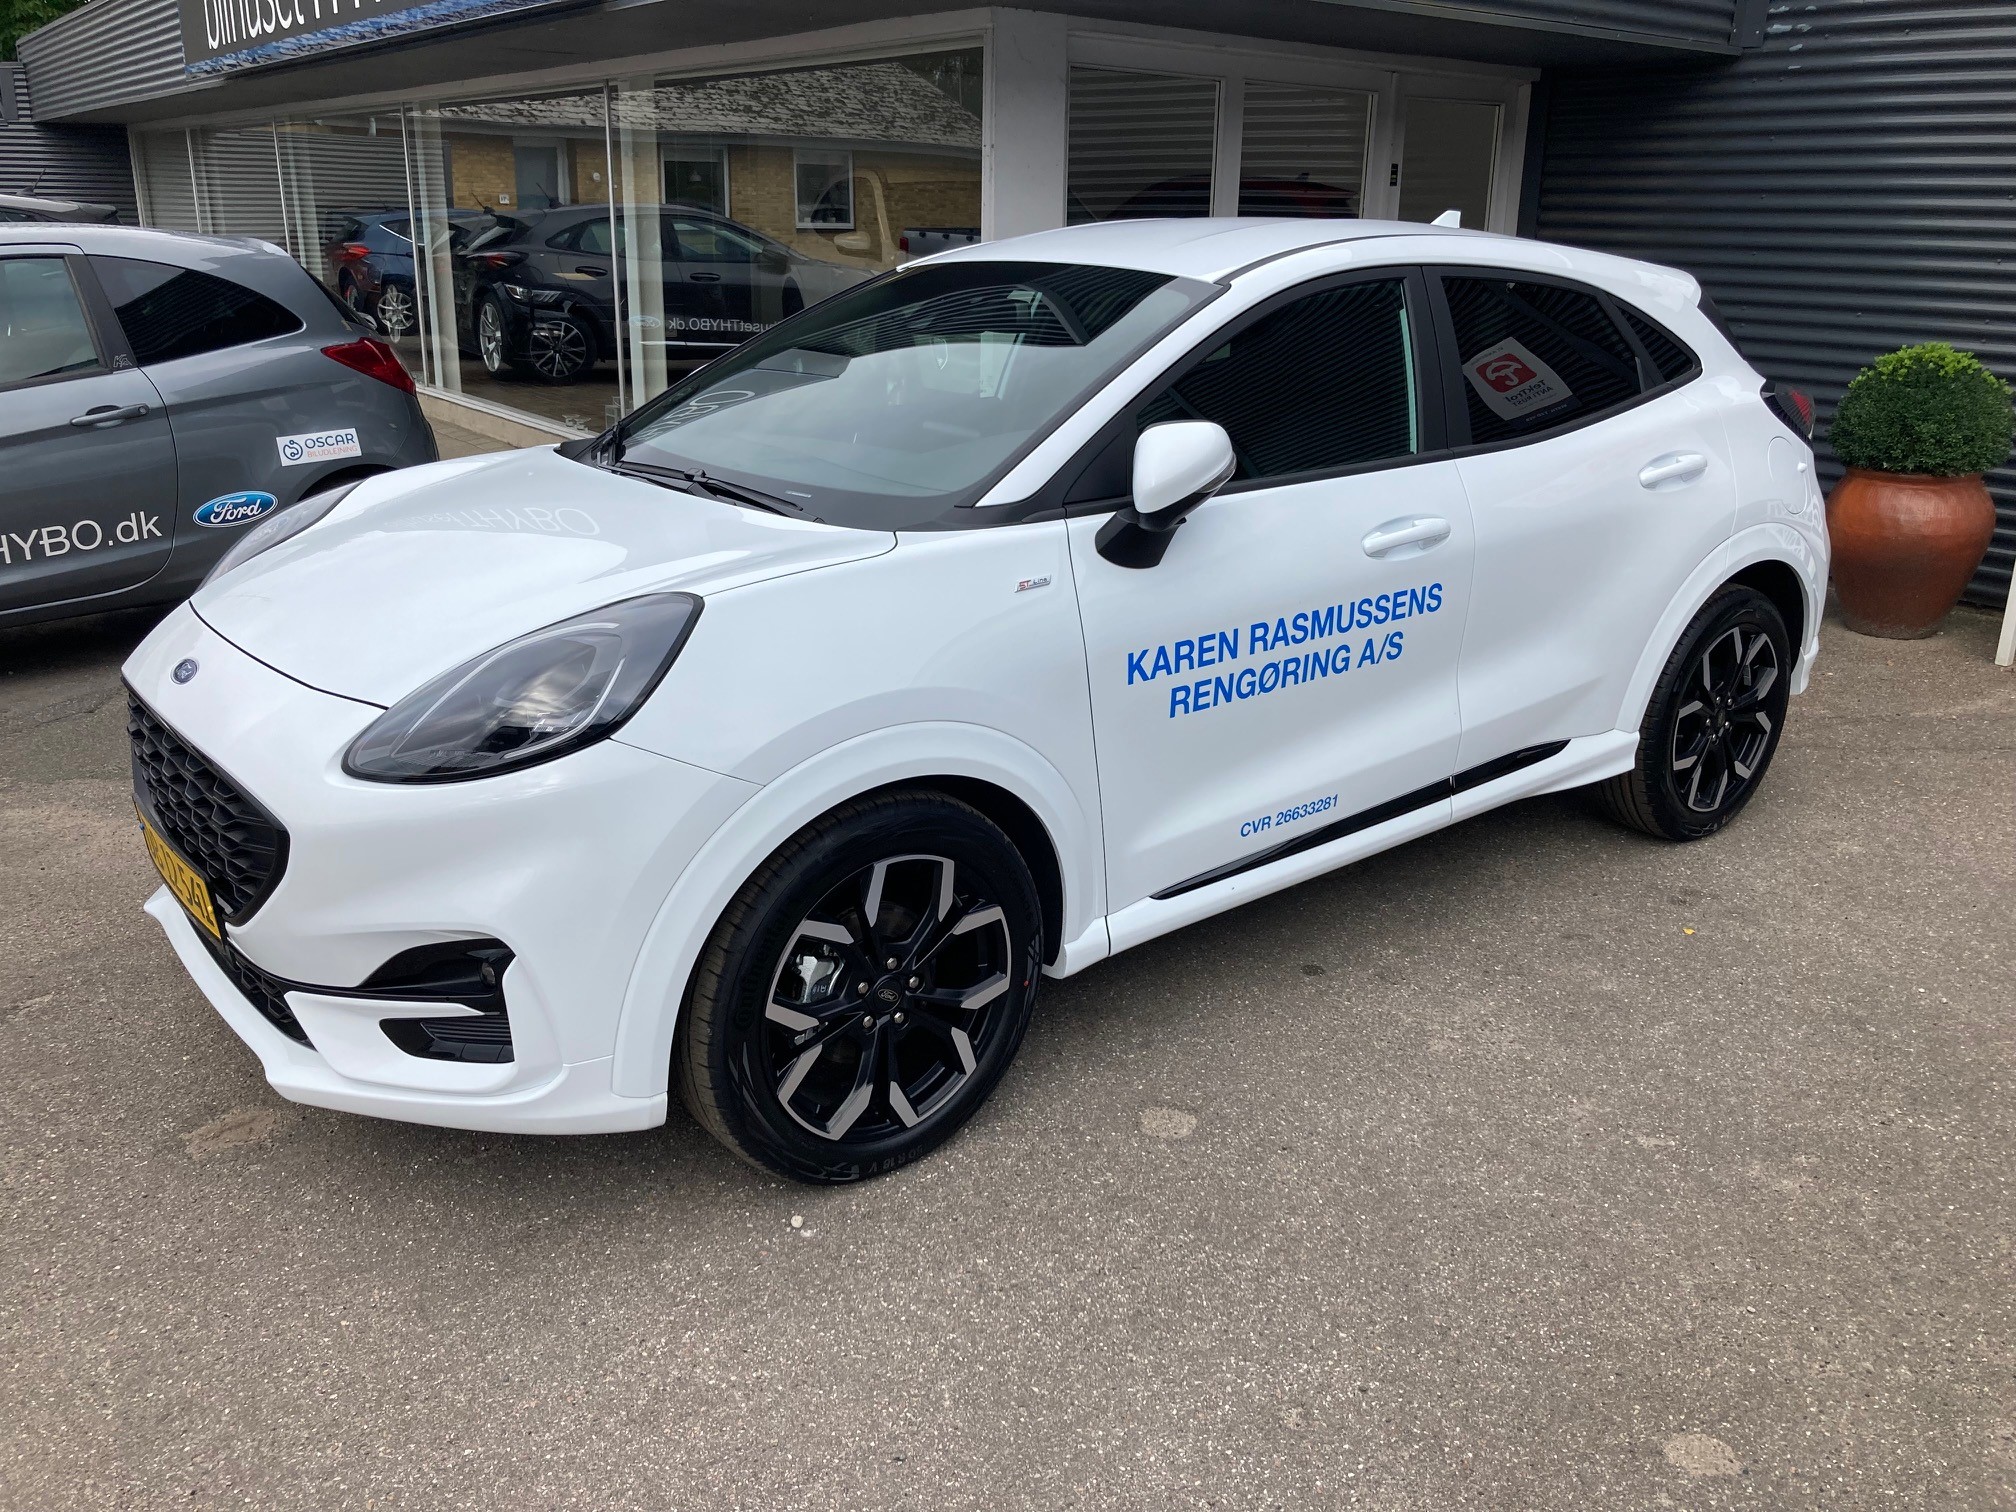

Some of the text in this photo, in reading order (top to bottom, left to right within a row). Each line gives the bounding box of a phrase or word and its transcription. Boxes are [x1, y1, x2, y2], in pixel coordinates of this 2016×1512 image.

[304, 433, 356, 449] OSCAR
[307, 445, 358, 458] BILUDLEJNING
[210, 496, 262, 524] Ford
[1127, 582, 1443, 686] KAREN RASMUSSENS
[1169, 631, 1404, 719] RENGØRING A/S
[1240, 794, 1339, 838] CVR 26633281
